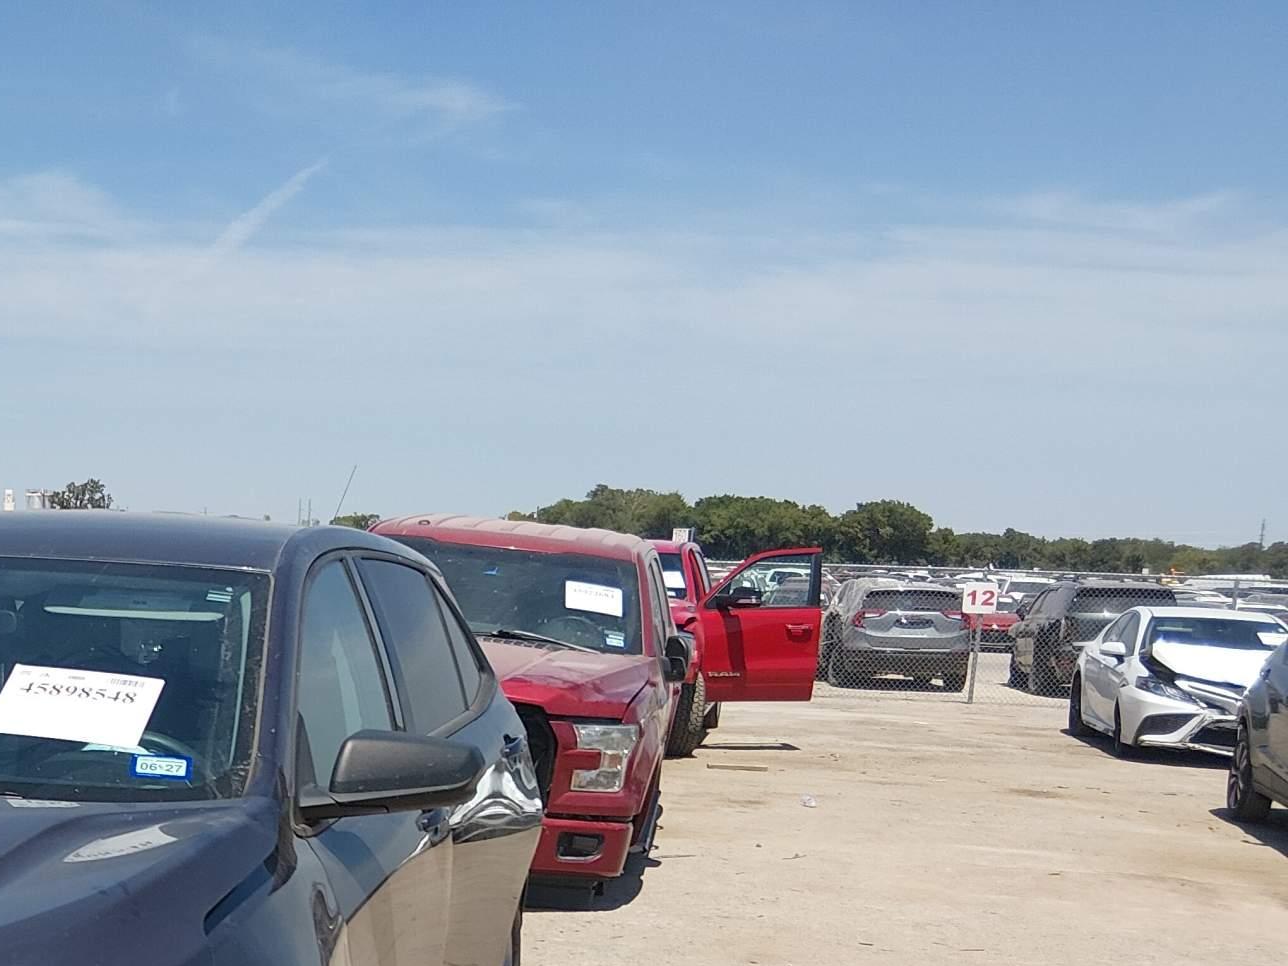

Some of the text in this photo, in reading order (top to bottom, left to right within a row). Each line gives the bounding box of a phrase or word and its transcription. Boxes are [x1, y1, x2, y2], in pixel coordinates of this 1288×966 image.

[967, 589, 996, 607] 12
[19, 681, 138, 705] 45898548
[140, 761, 158, 772] 06
[164, 763, 183, 774] 27
